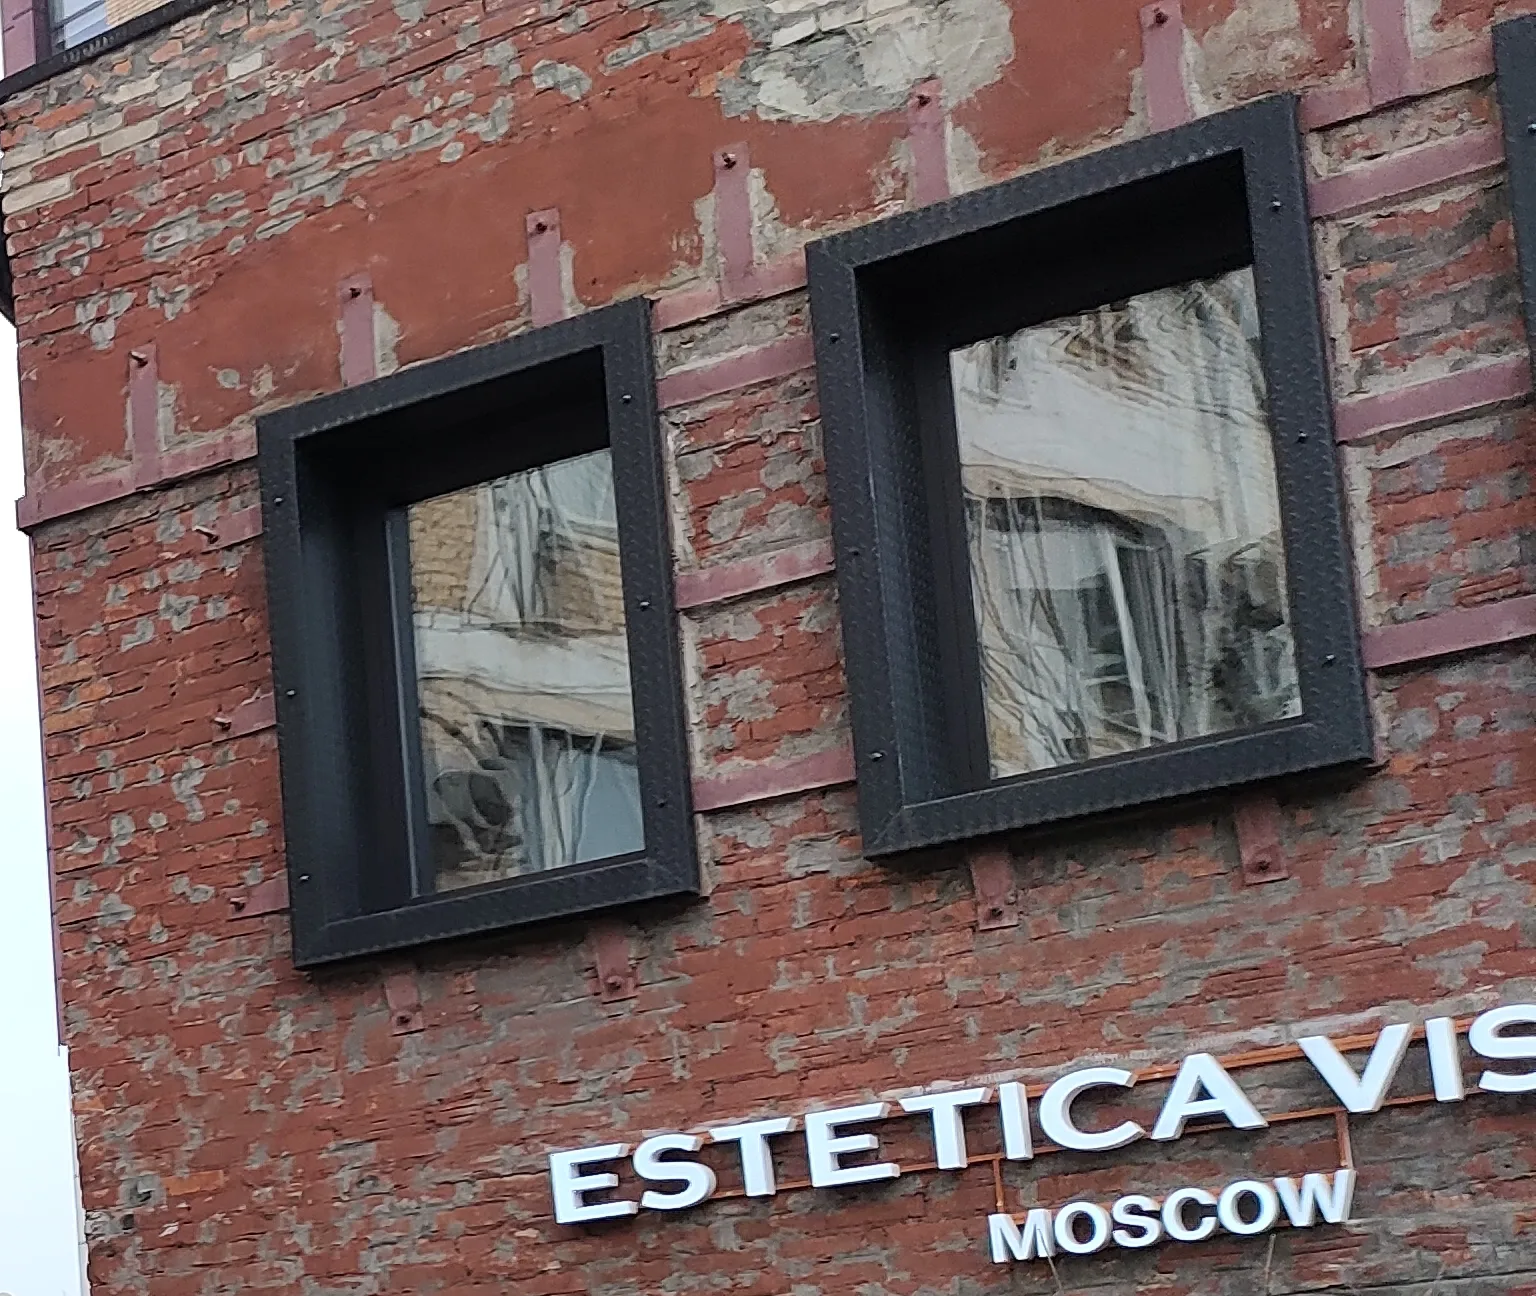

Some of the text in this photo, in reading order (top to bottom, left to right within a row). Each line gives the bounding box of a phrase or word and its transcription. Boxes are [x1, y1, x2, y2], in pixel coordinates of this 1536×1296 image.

[549, 1003, 1536, 1225] ESTETICA VIS
[988, 1168, 1357, 1264] MOSCOW
